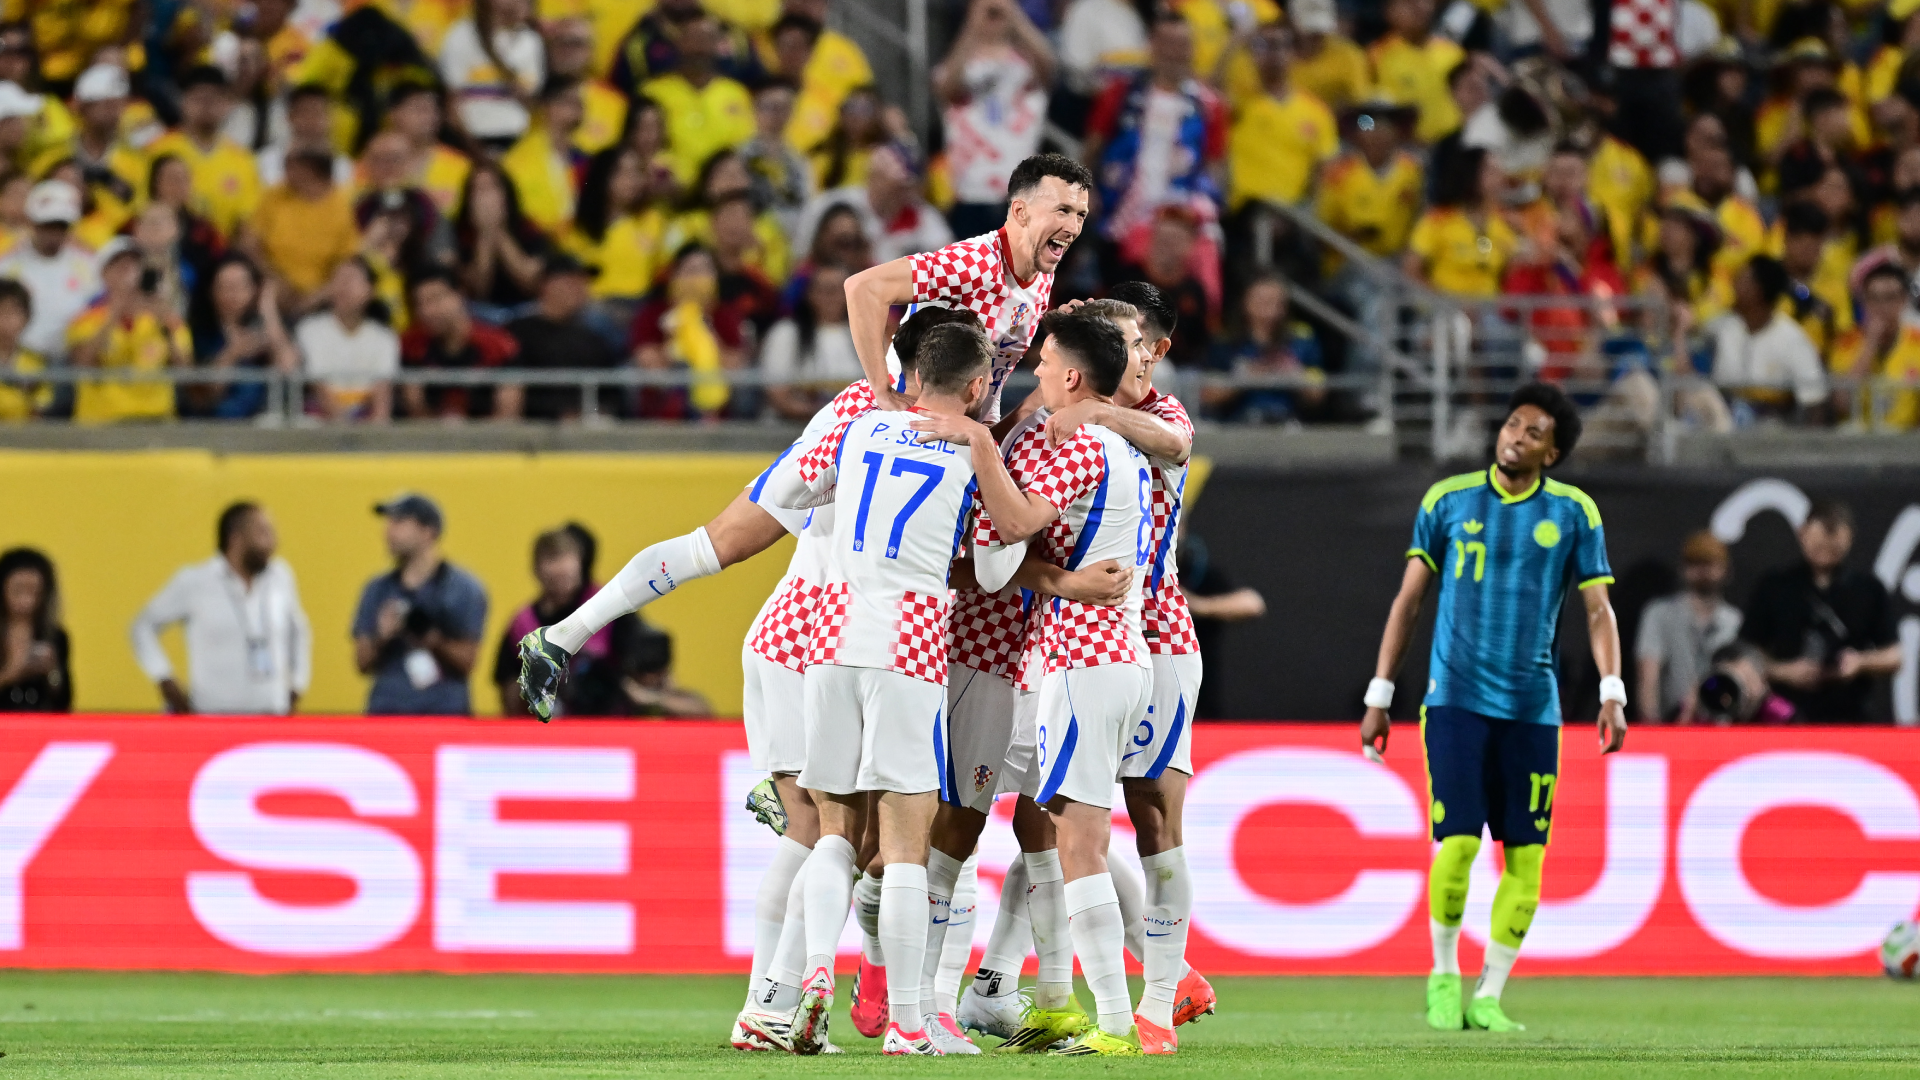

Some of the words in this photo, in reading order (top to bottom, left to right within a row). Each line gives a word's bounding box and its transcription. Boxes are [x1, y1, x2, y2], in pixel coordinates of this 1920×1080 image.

[870, 422, 889, 441] P.
[852, 451, 945, 560] 17
[1136, 467, 1152, 566] 8
[1455, 539, 1486, 582] 17
[1529, 772, 1557, 812] 17
[185, 742, 637, 957] SE
[936, 898, 951, 908] HN
[1147, 916, 1174, 927] HNS
